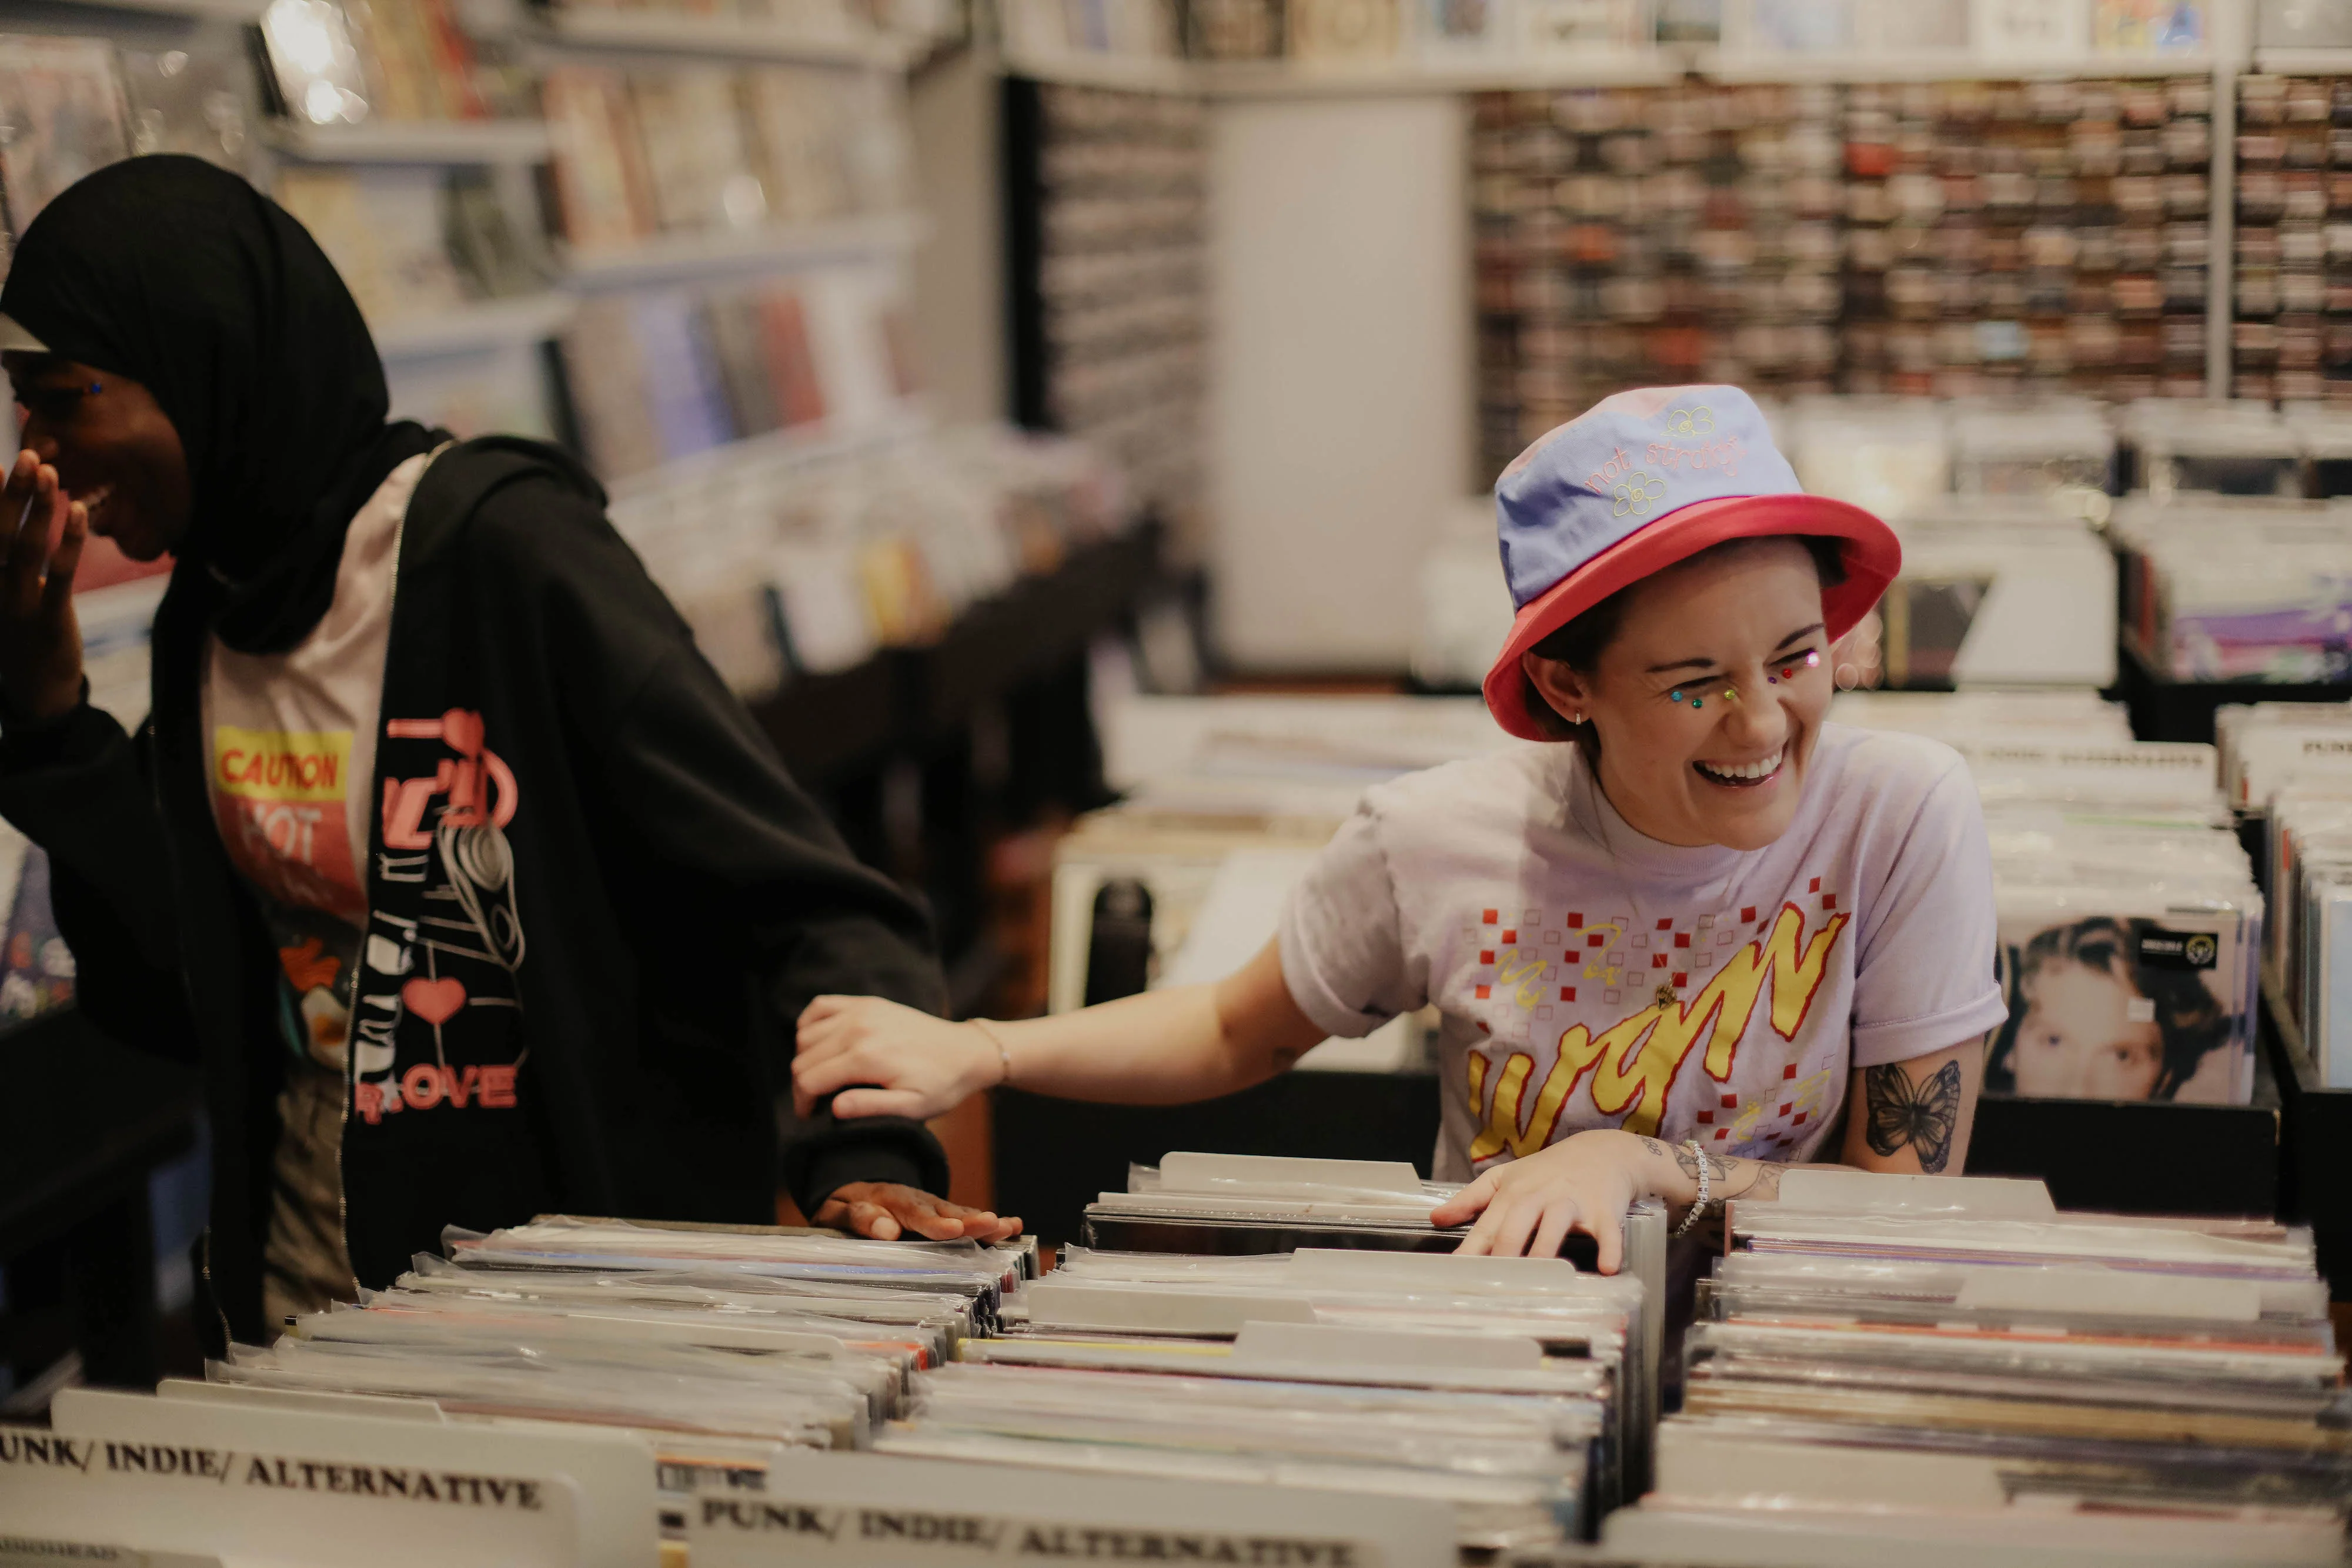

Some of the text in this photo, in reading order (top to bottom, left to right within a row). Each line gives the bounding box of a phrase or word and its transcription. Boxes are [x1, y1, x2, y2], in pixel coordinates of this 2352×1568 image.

[1584, 446, 1631, 494] not
[105, 1440, 233, 1484] INDIE/
[244, 1457, 542, 1510] ALTERNATIVE
